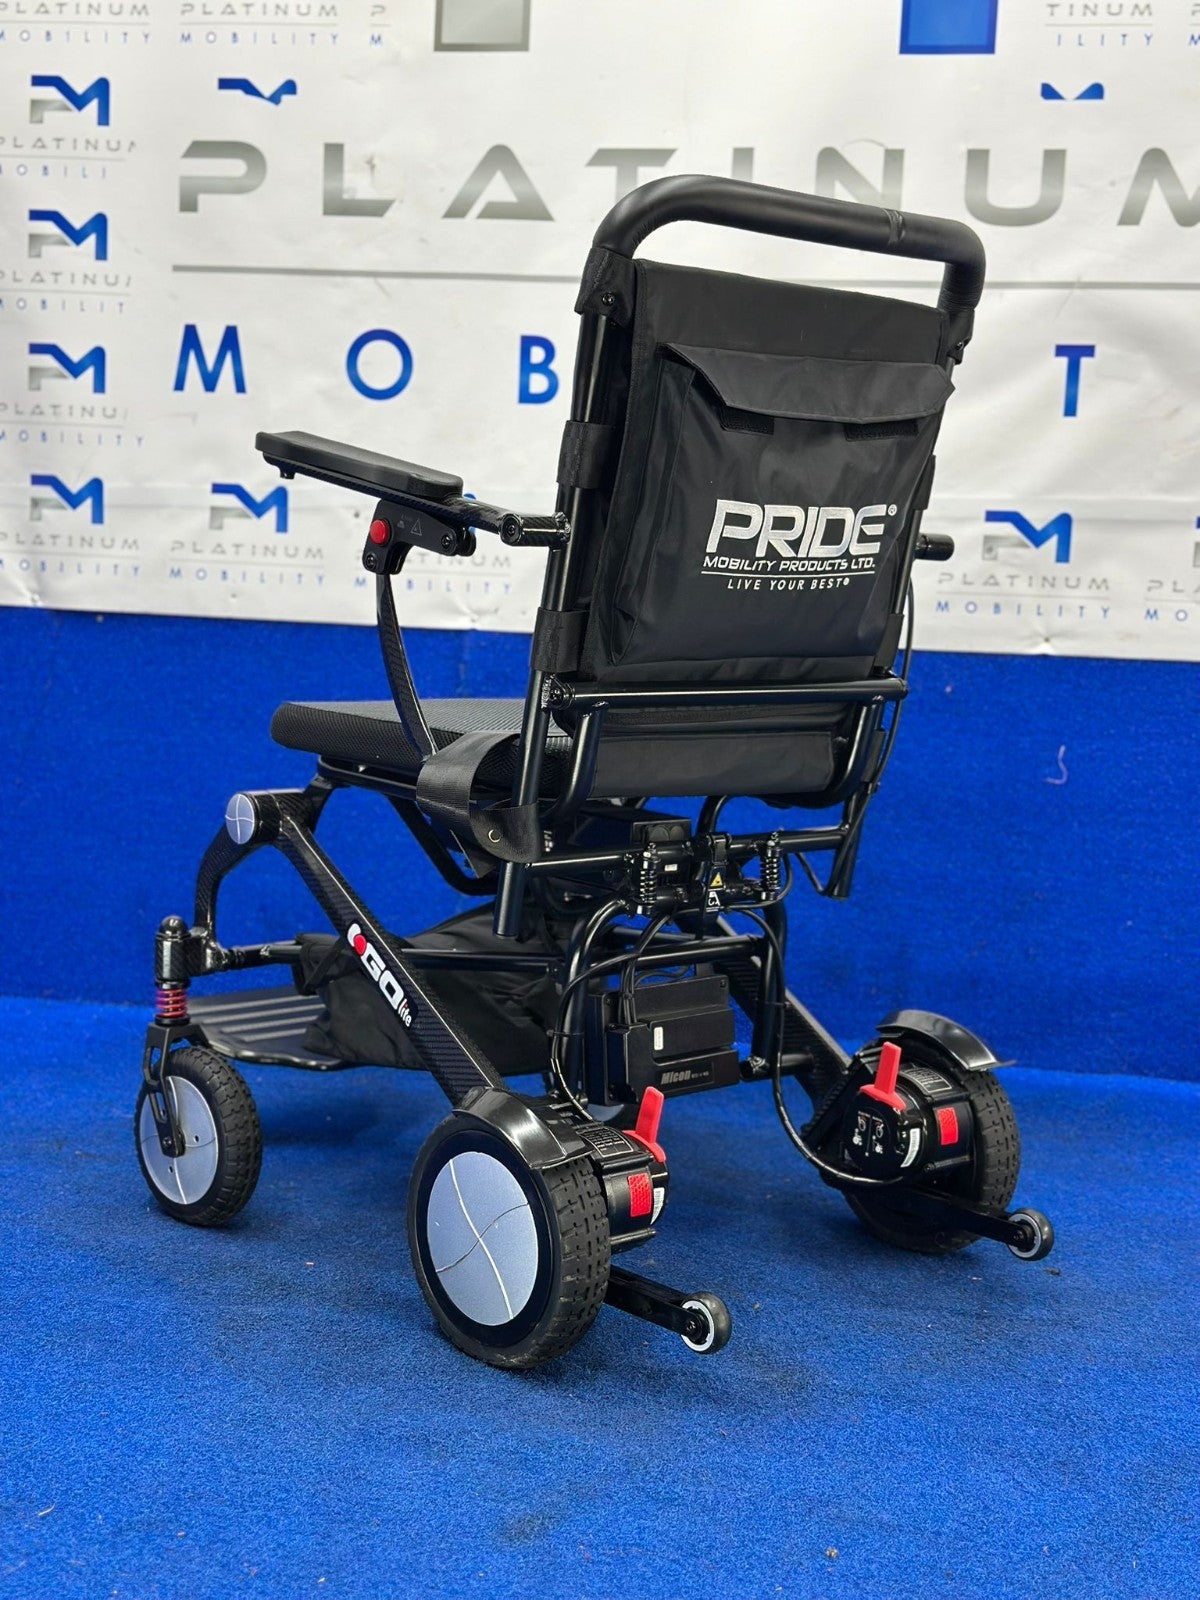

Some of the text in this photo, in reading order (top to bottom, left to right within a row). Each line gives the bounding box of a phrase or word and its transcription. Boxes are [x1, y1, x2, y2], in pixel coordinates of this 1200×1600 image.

[180, 3, 338, 17] PLATINUM
[180, 31, 338, 44] MOBILITY
[170, 540, 324, 559] PLATINUM
[703, 555, 876, 572] MOBILITY PRODUCTS LTD.
[169, 567, 324, 585] MOBILITY
[727, 578, 762, 590] LIVE
[769, 580, 805, 590] YOUR
[938, 572, 1109, 590] PLATINUM
[355, 577, 511, 593] MBILITY
[936, 600, 1110, 618] MOBILITY
